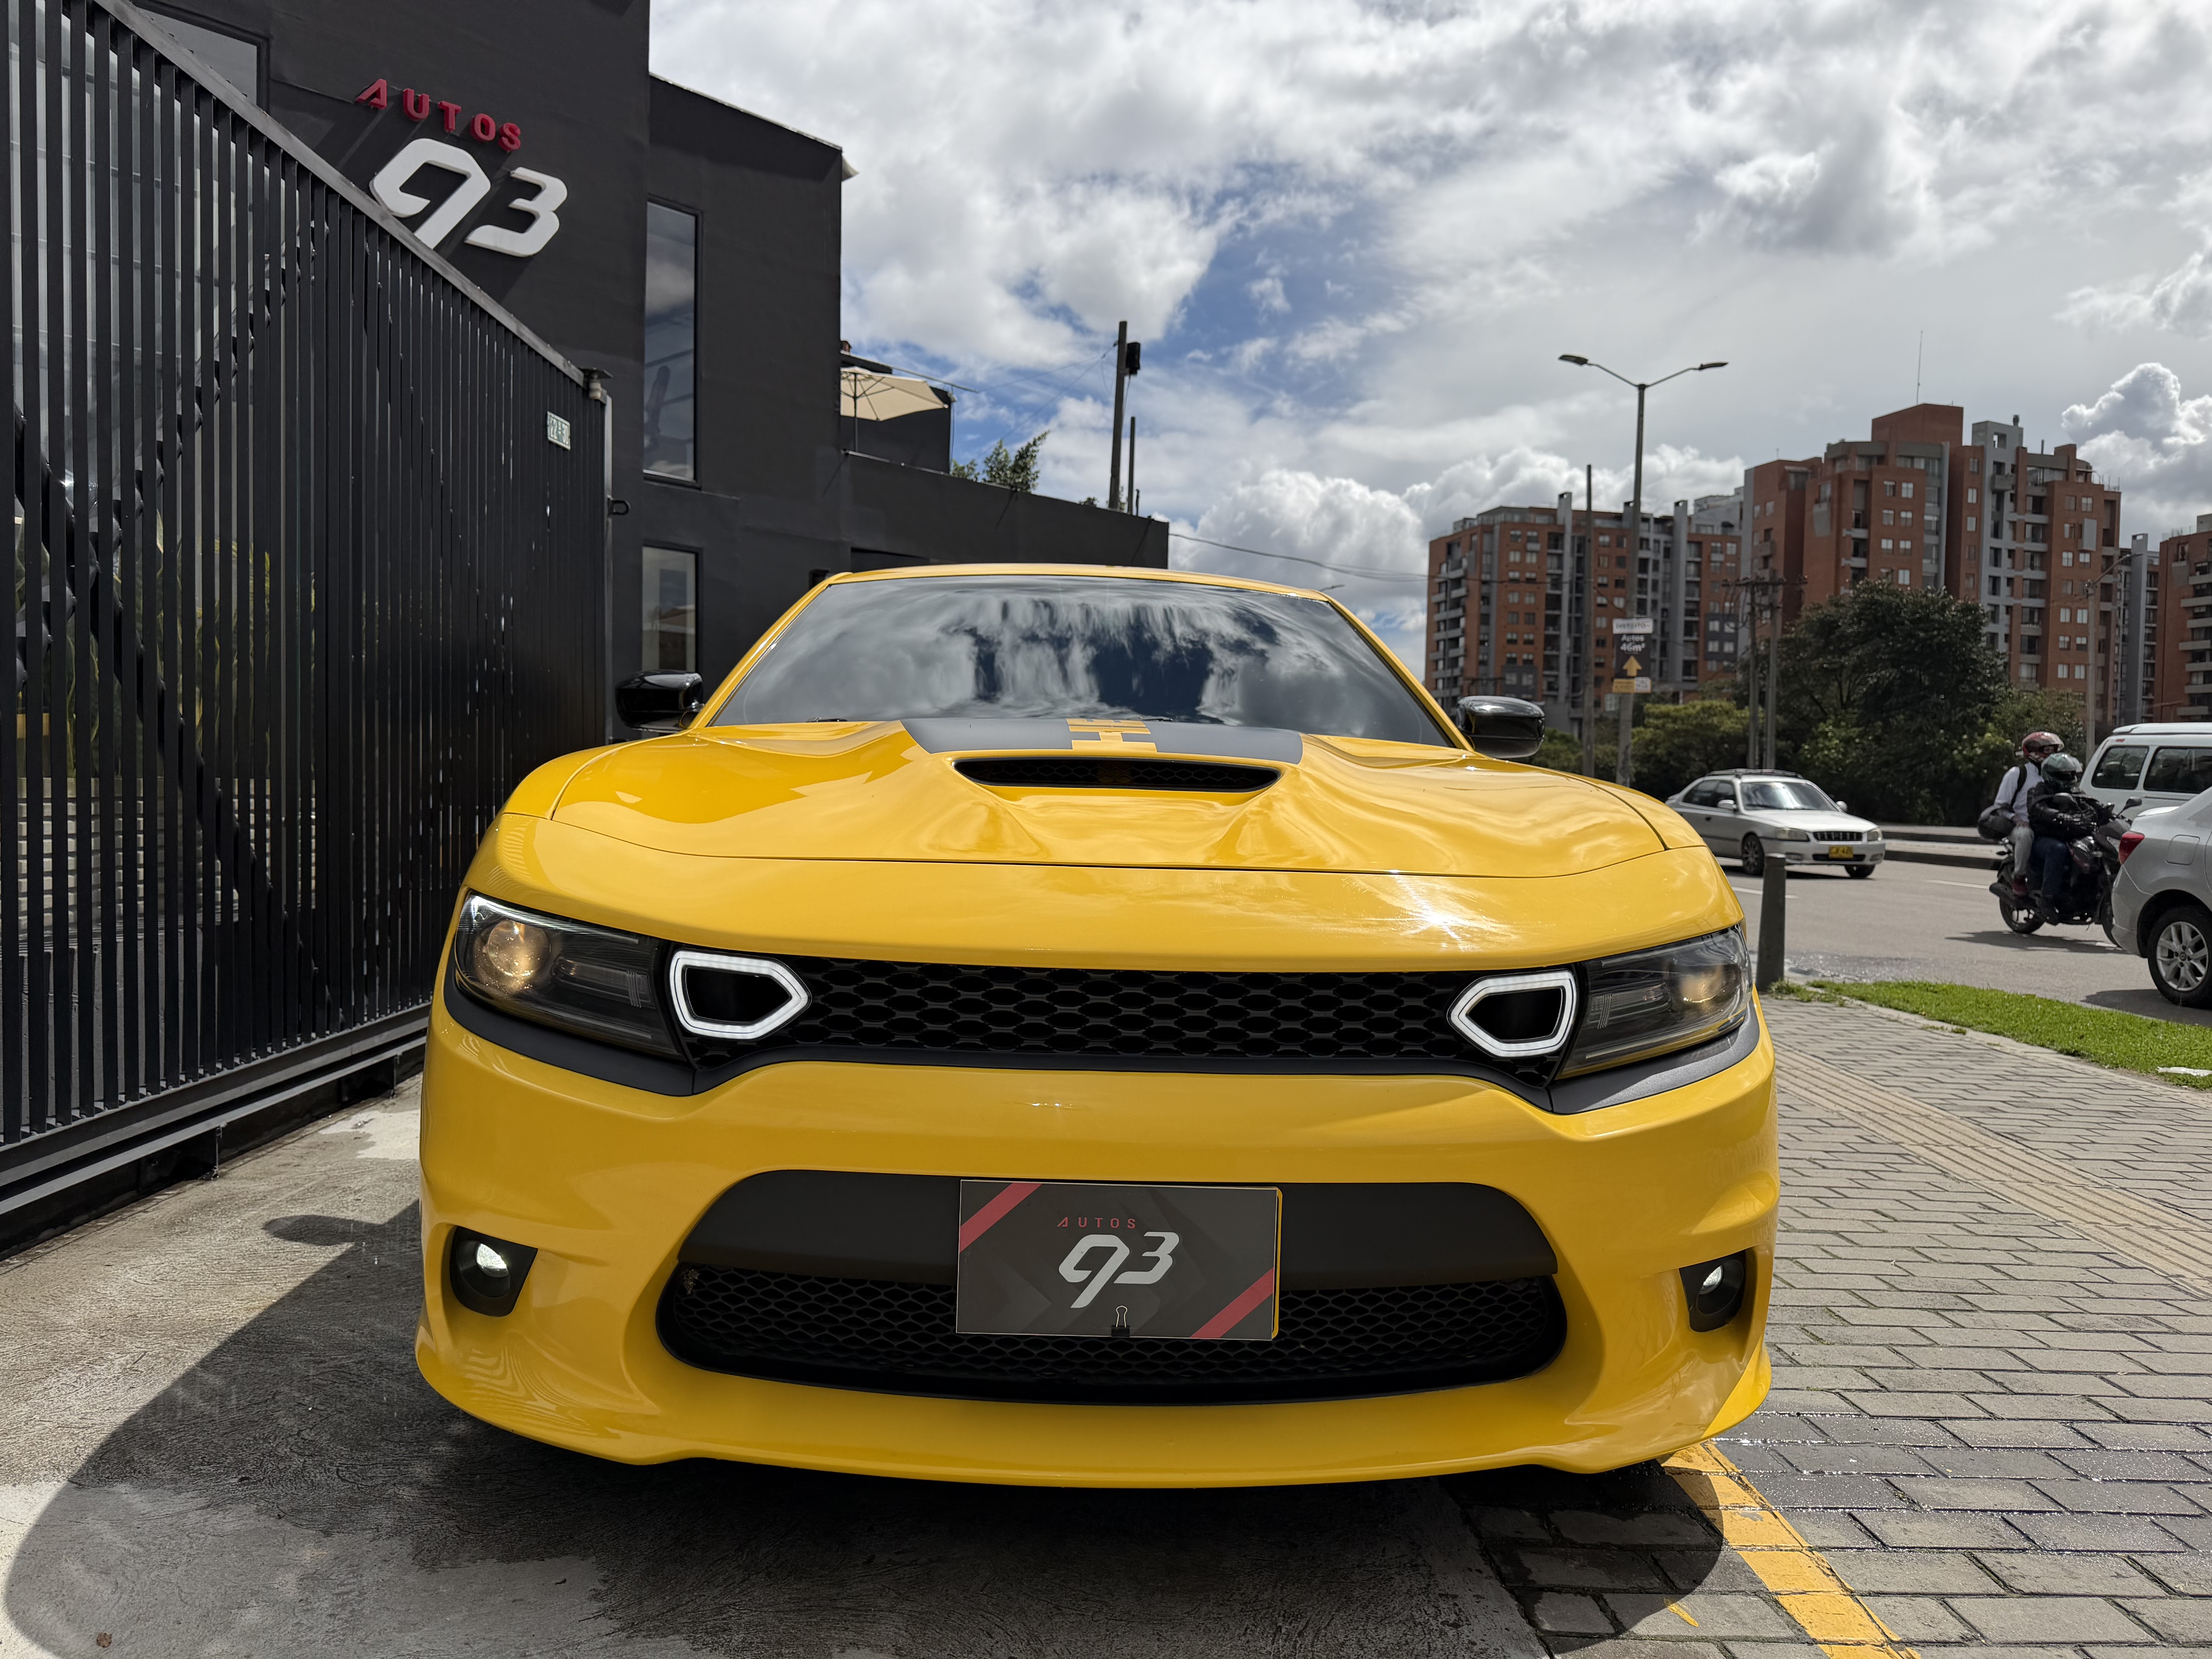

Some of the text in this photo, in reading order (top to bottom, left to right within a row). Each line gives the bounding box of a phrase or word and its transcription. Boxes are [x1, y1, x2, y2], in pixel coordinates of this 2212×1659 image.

[355, 79, 521, 151] AUTOS
[369, 138, 567, 257] 93
[1057, 1217, 1137, 1229] AUTOS
[1058, 1231, 1180, 1308] 93
